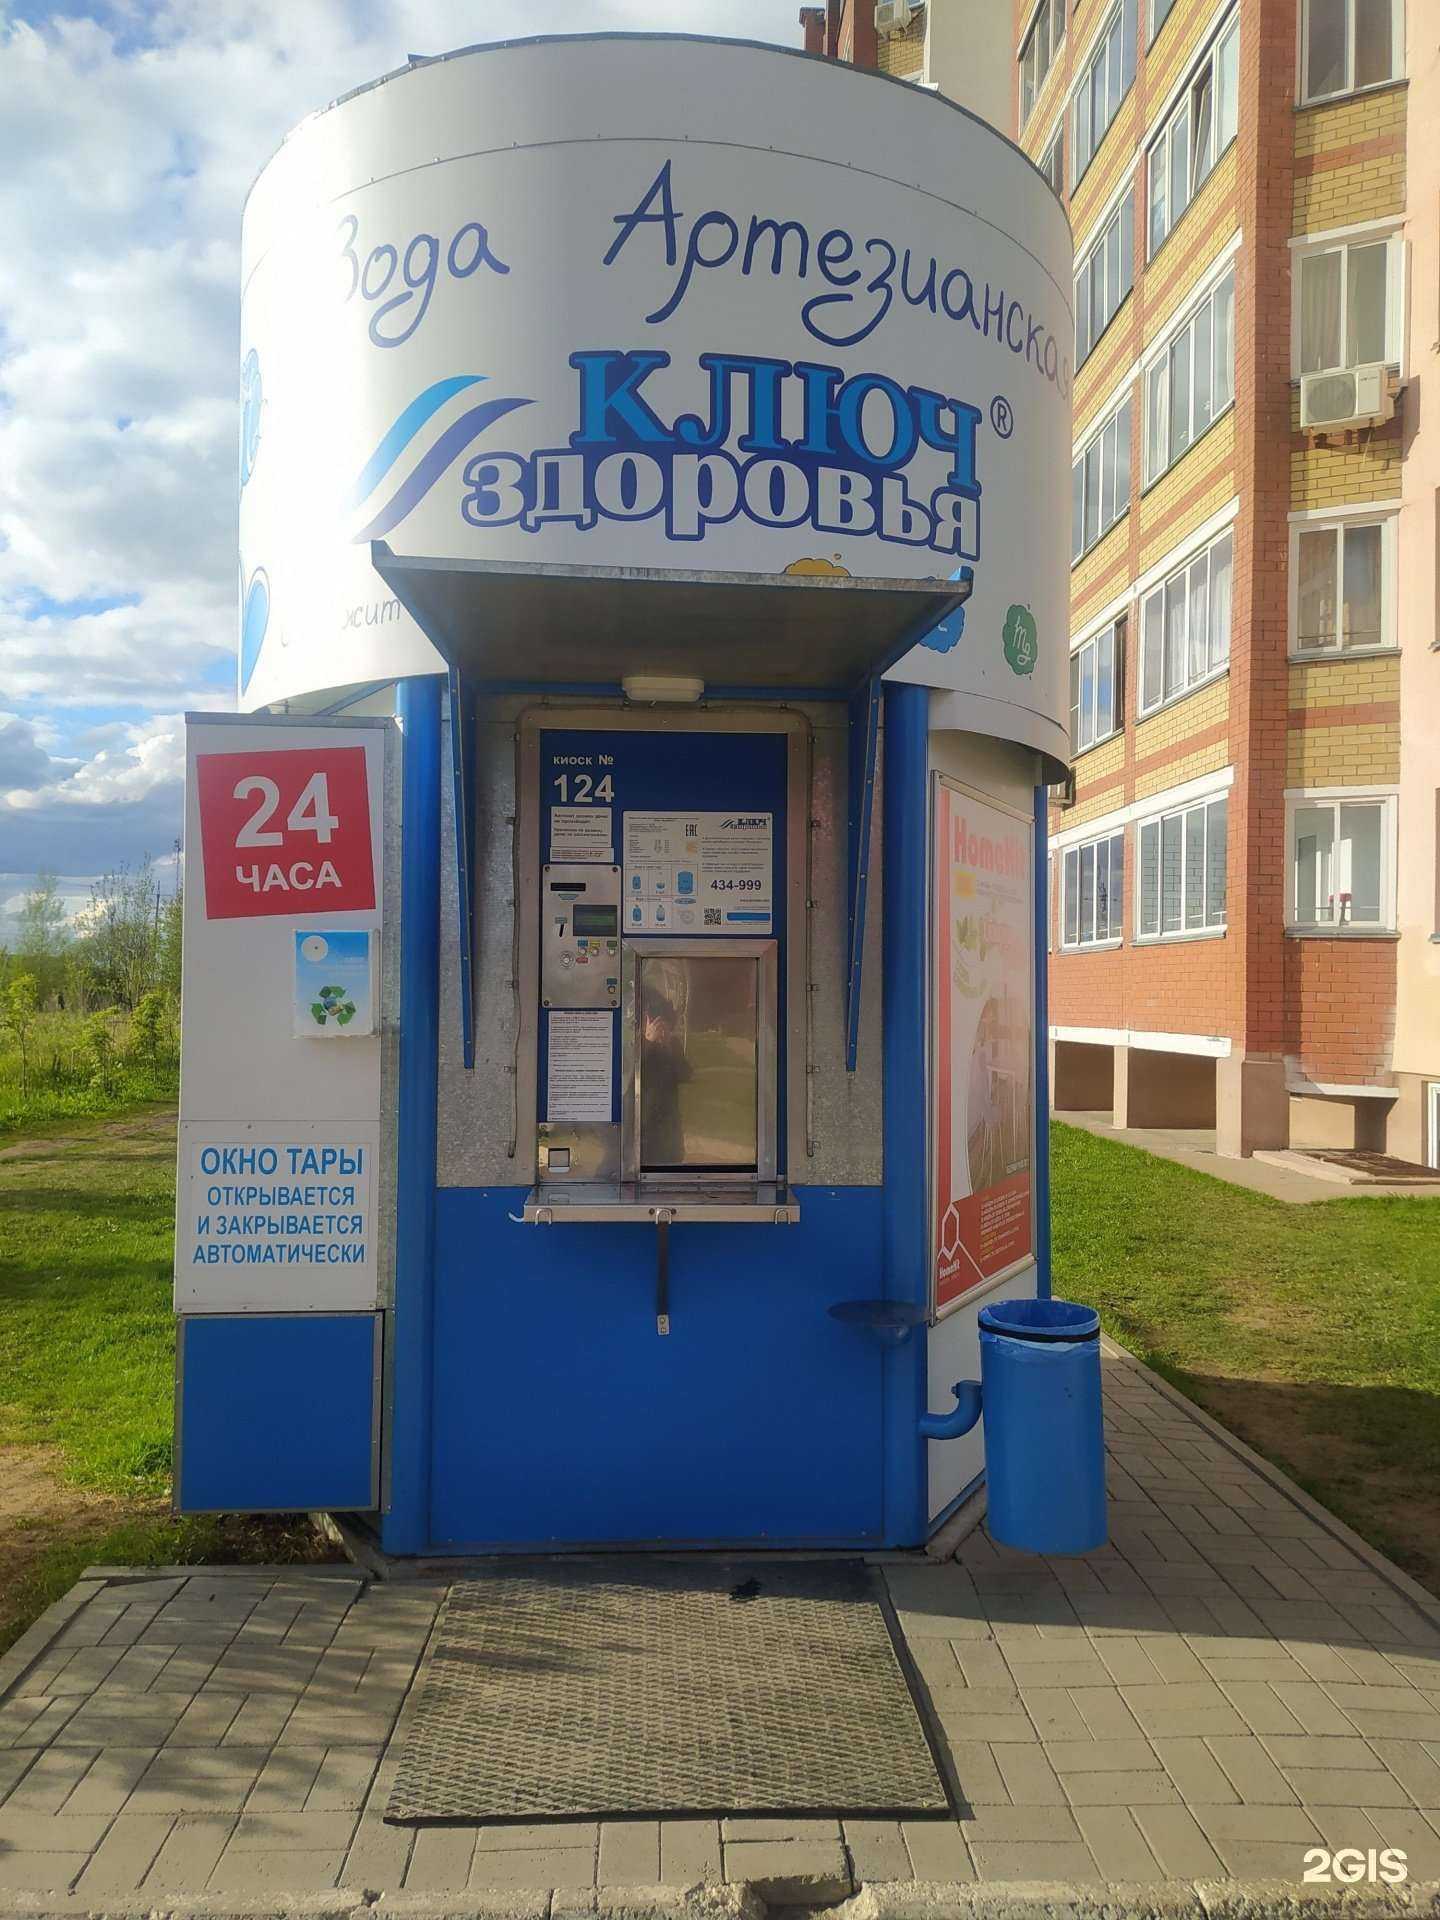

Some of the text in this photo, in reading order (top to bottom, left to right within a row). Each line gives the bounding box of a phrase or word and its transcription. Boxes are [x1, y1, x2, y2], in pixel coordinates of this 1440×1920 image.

[569, 349, 982, 495] КЛЮЧ
[460, 450, 982, 561] здоровья
[553, 774, 615, 803] 124
[232, 772, 340, 848] 24
[235, 861, 343, 893] ЧАСА
[710, 879, 762, 891] 434-999
[201, 1147, 363, 1175] ОКНО ТАРЫ
[207, 1186, 355, 1206] ОТКРЫВАЕТСЯ
[197, 1215, 363, 1235] И ЗАКРЫВАЕТСЯ
[193, 1244, 365, 1264] АВТОМАТИЧЕСКИ
